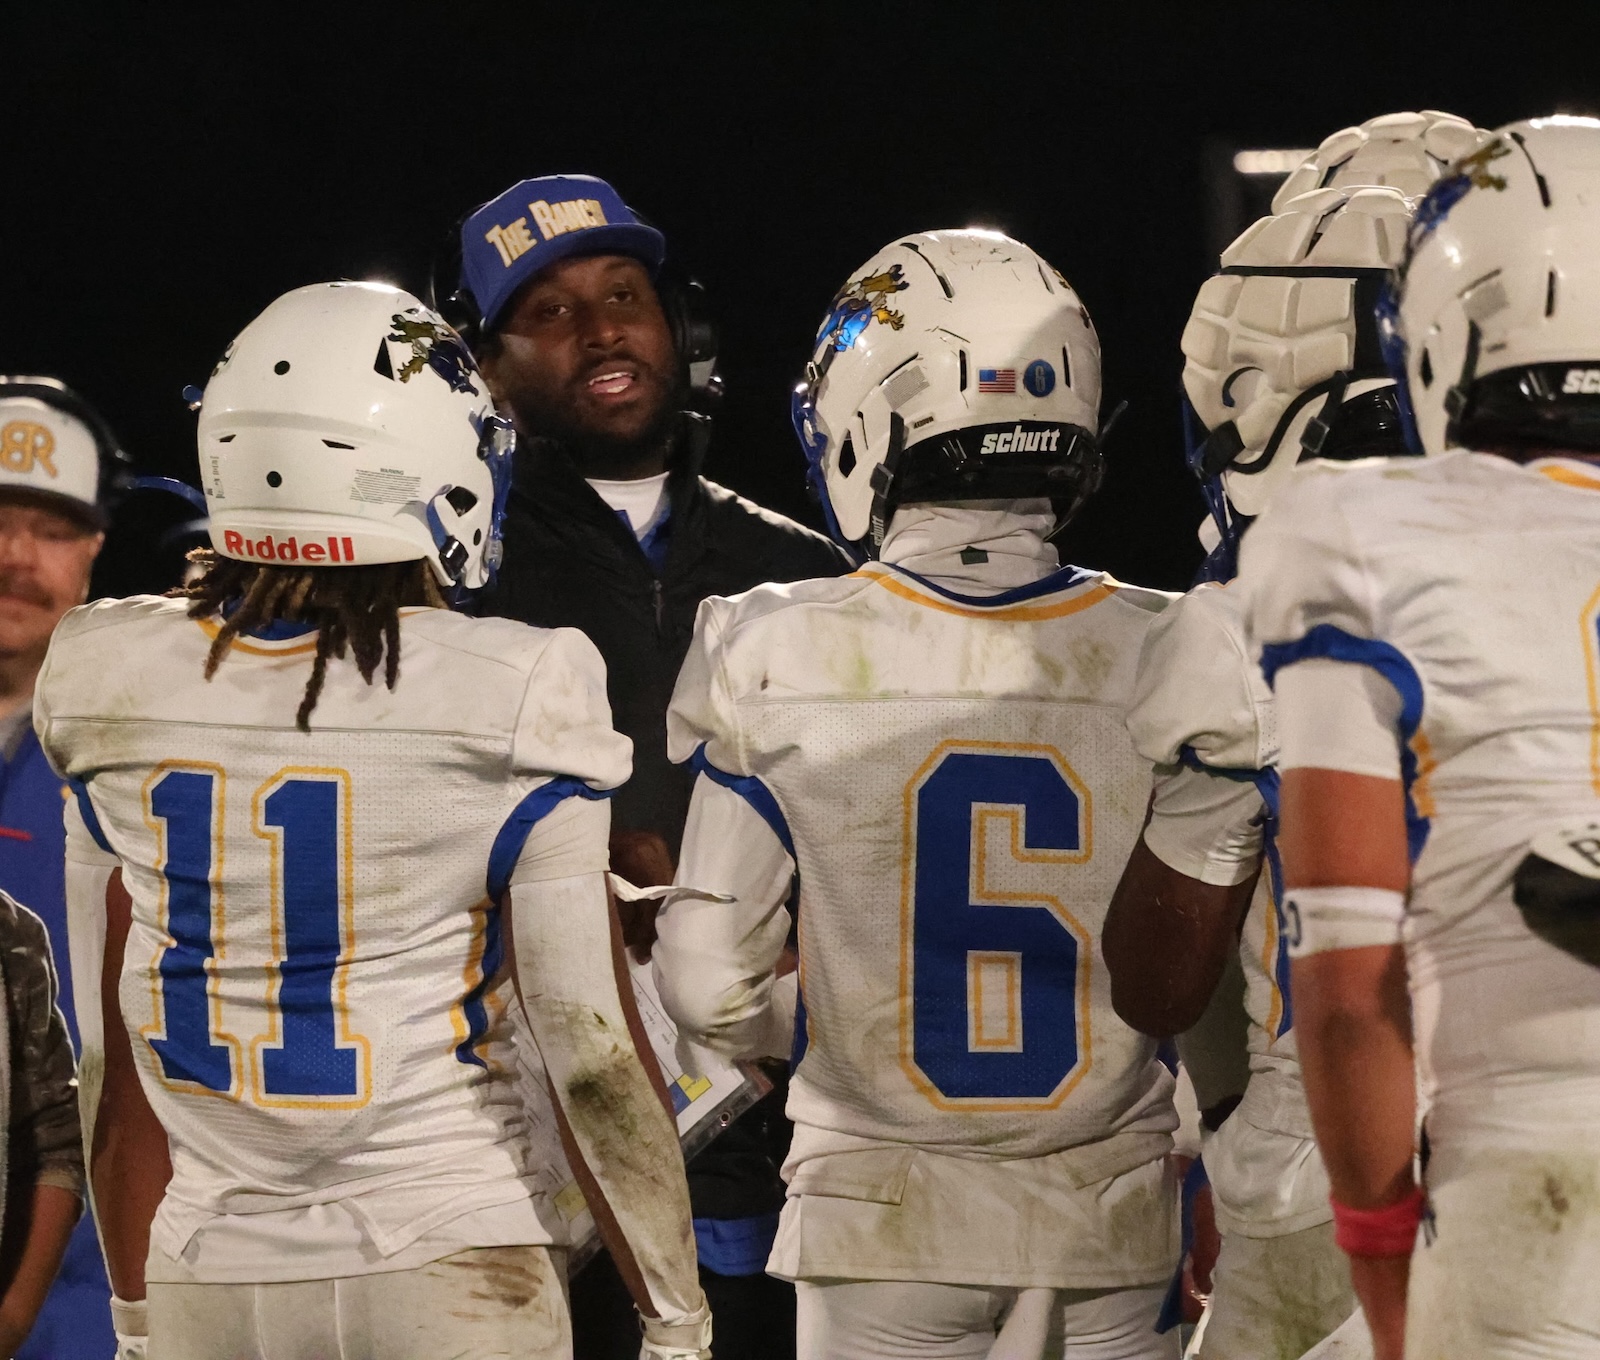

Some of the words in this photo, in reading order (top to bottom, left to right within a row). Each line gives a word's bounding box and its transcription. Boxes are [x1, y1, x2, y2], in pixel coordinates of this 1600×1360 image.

[484, 216, 538, 268] THE
[1035, 365, 1046, 393] 6
[980, 425, 1060, 455] schutt
[224, 529, 355, 563] Riddell
[140, 758, 372, 1110] 11
[899, 739, 1093, 1112] 6
